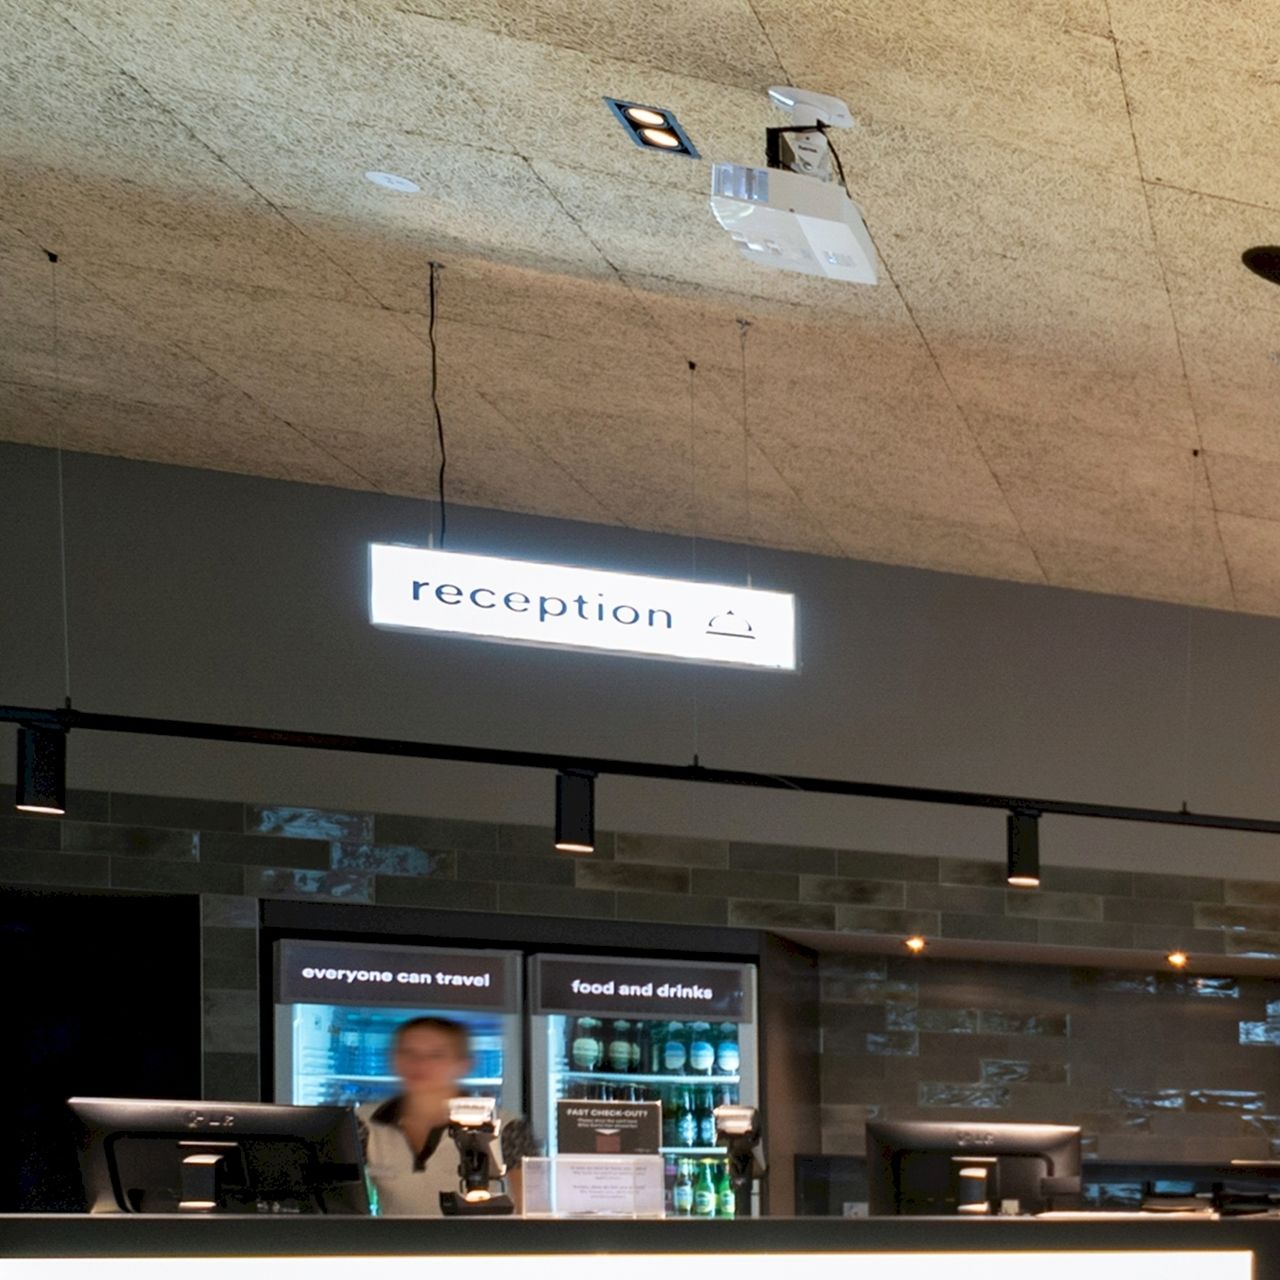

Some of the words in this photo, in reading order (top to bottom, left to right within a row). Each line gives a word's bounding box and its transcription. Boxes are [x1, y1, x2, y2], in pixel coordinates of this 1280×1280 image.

[411, 579, 673, 630] reception
[302, 966, 393, 984] everyone
[397, 972, 432, 985] can
[435, 971, 491, 988] travel
[571, 979, 615, 996] food
[618, 982, 653, 997] and
[656, 983, 713, 1000] drinks
